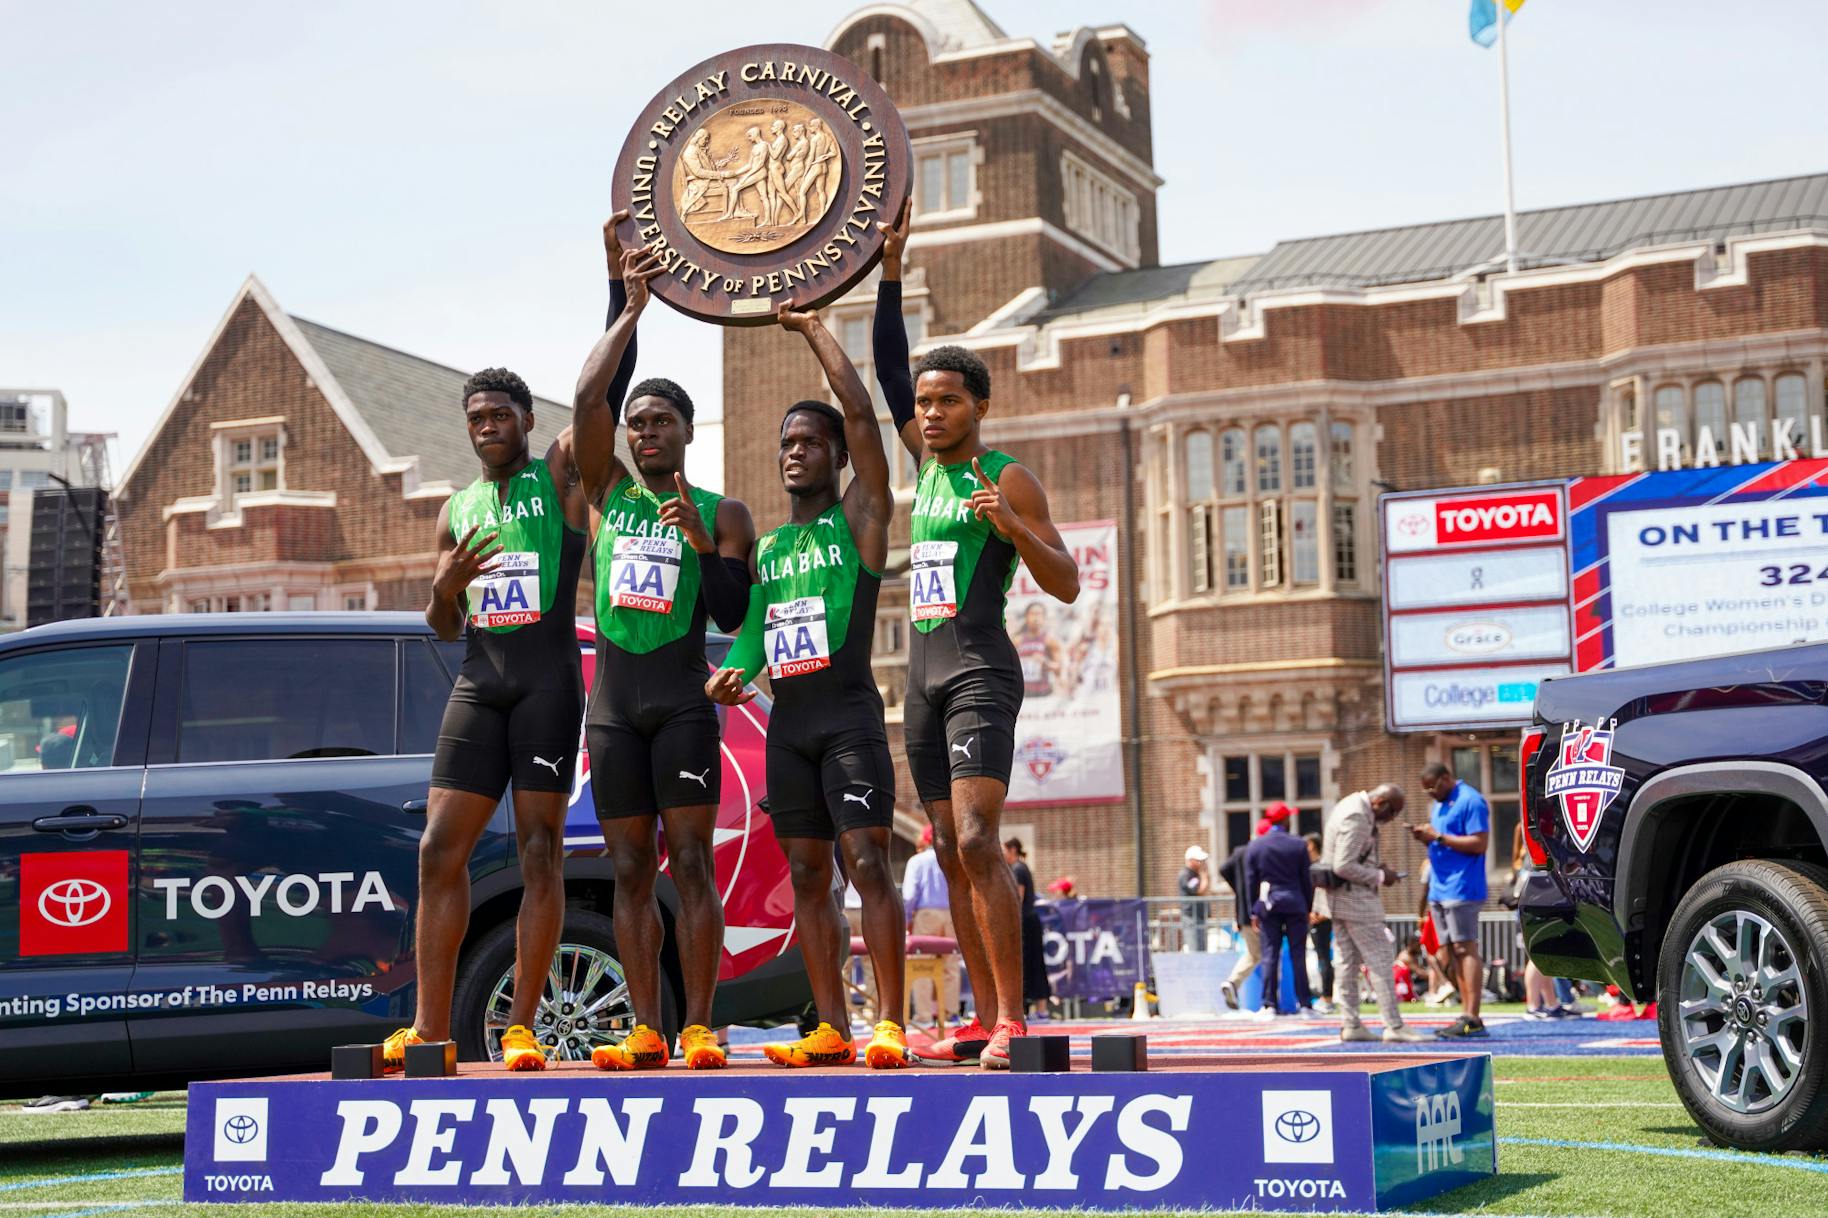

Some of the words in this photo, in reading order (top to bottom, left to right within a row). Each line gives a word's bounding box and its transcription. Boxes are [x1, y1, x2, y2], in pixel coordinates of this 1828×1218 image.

[651, 70, 728, 140] RELAY
[740, 61, 869, 121] CARNIVAL
[632, 155, 720, 292] UNIVERSITY
[723, 278, 745, 293] OF
[751, 131, 886, 295] PENNSYLVANIA
[605, 509, 688, 543] CALABA
[1440, 502, 1554, 533] TOYOTA
[1639, 523, 1699, 546] ON
[1712, 516, 1800, 541] THE
[640, 545, 674, 554] RELAYS
[761, 544, 843, 586] ALABAR
[481, 579, 529, 612] AA
[614, 563, 664, 597] AA
[913, 570, 946, 605] AA
[621, 595, 666, 611] TOYOTA
[916, 606, 950, 617] TOYOTA
[1620, 602, 1699, 617] College
[1705, 592, 1803, 613] Women's
[490, 614, 533, 625] TOYOTA
[1663, 616, 1819, 639] Championship
[774, 626, 818, 662] AA
[782, 660, 823, 674] TOYOTA
[1424, 684, 1495, 708] College
[1548, 772, 1577, 791] PENN
[1578, 770, 1621, 786] RELAYS
[153, 870, 395, 920] TOYOTA
[1043, 930, 1124, 966] OTA
[66, 993, 163, 1016] Sponsor
[168, 986, 192, 1006] of
[196, 984, 237, 1004] The
[243, 984, 297, 1002] Penn
[303, 979, 372, 1002] Relays
[319, 1097, 664, 1187] PENN
[678, 1093, 1194, 1192] RELAYS
[204, 1175, 274, 1192] TOYOTA
[1254, 1179, 1346, 1198] TOYOTA
